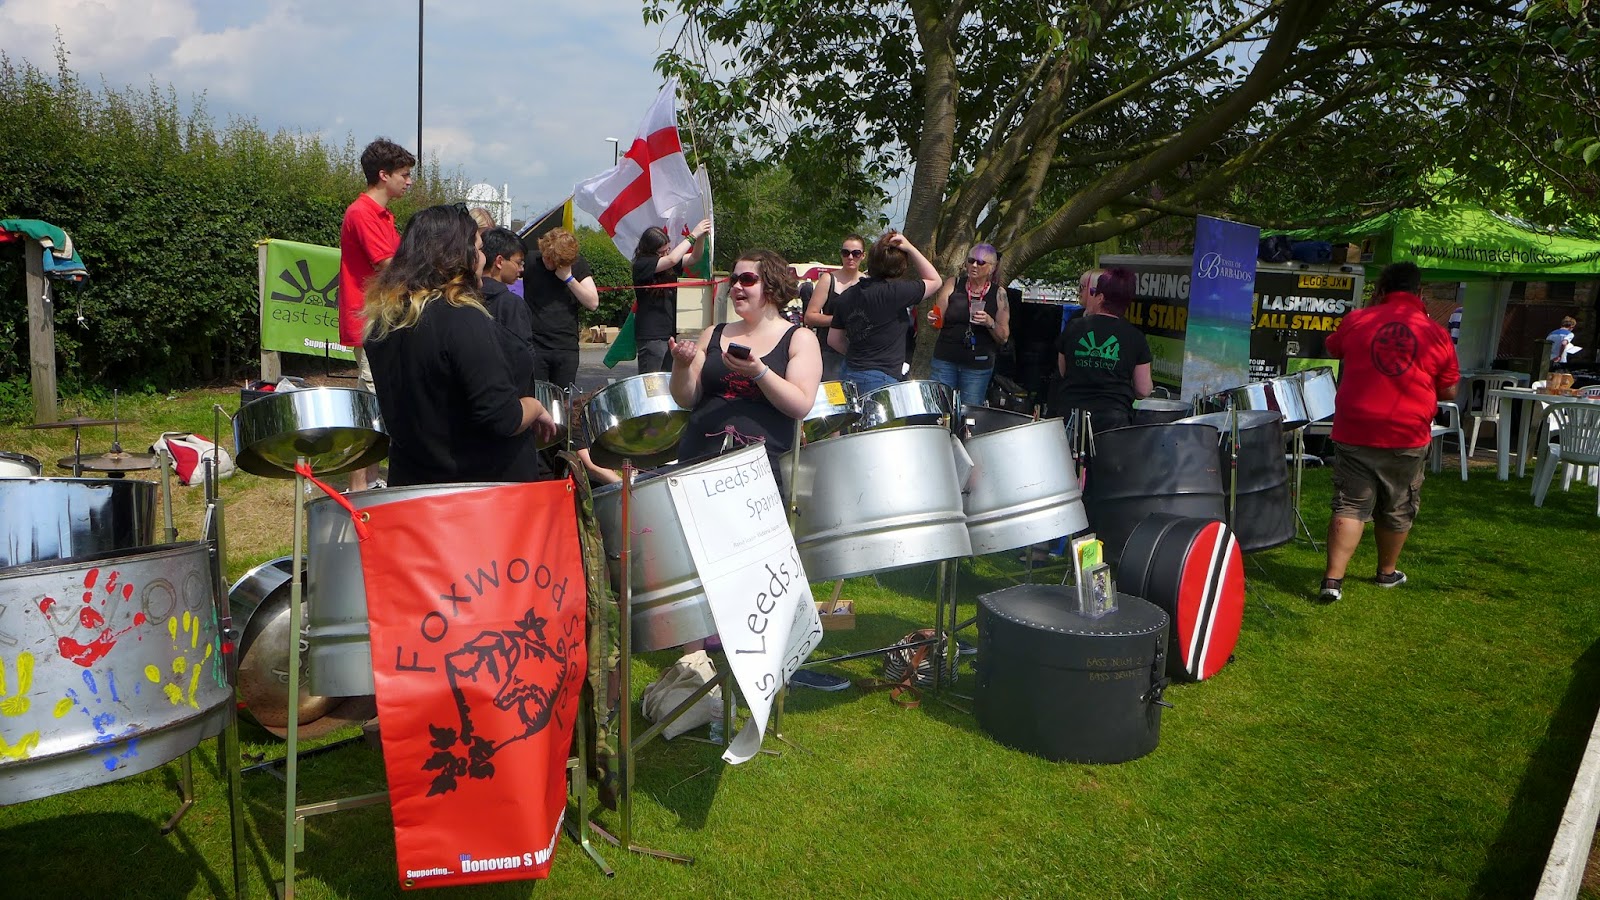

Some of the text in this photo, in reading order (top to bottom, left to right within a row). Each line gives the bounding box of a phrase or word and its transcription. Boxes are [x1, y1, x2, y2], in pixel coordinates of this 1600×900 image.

[1198, 251, 1252, 281] BARBADOS
[1303, 276, 1348, 288] LG05 JXW
[1262, 295, 1346, 314] LASHINGS
[272, 307, 308, 323] east
[1257, 313, 1289, 329] ALL
[1075, 358, 1092, 368] east
[702, 466, 750, 497] Leeds
[735, 563, 790, 655] Leeds
[461, 854, 521, 873] Donovan
[523, 852, 533, 867] S
